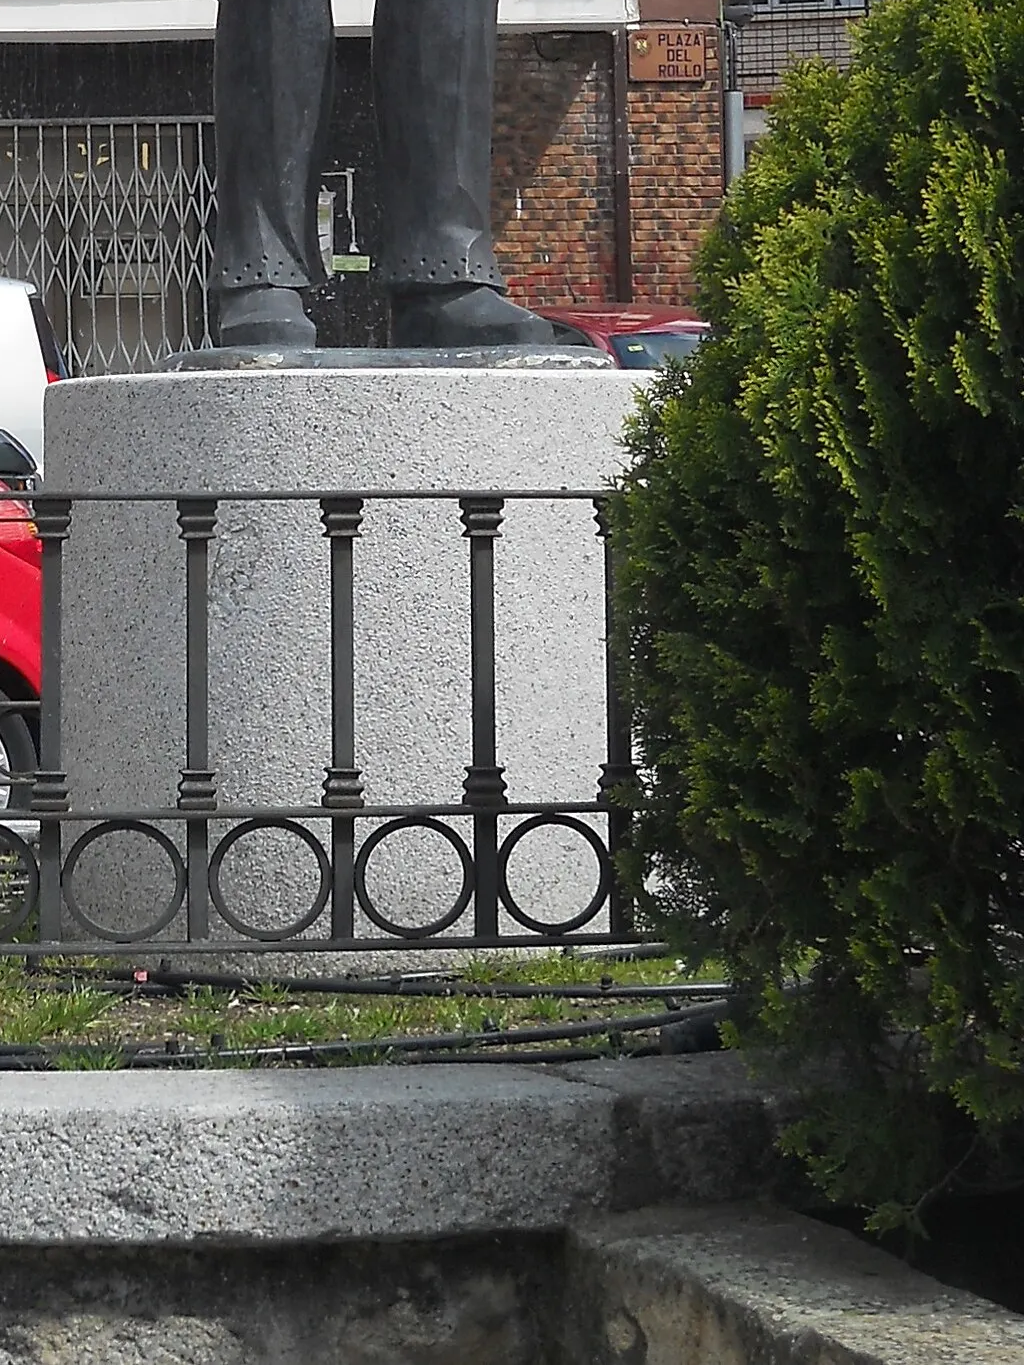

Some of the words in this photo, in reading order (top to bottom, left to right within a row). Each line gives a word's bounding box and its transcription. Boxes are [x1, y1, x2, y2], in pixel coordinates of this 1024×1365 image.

[658, 34, 701, 46] PLAZA
[667, 49, 692, 62] DEL
[658, 64, 702, 77] ROLLO
